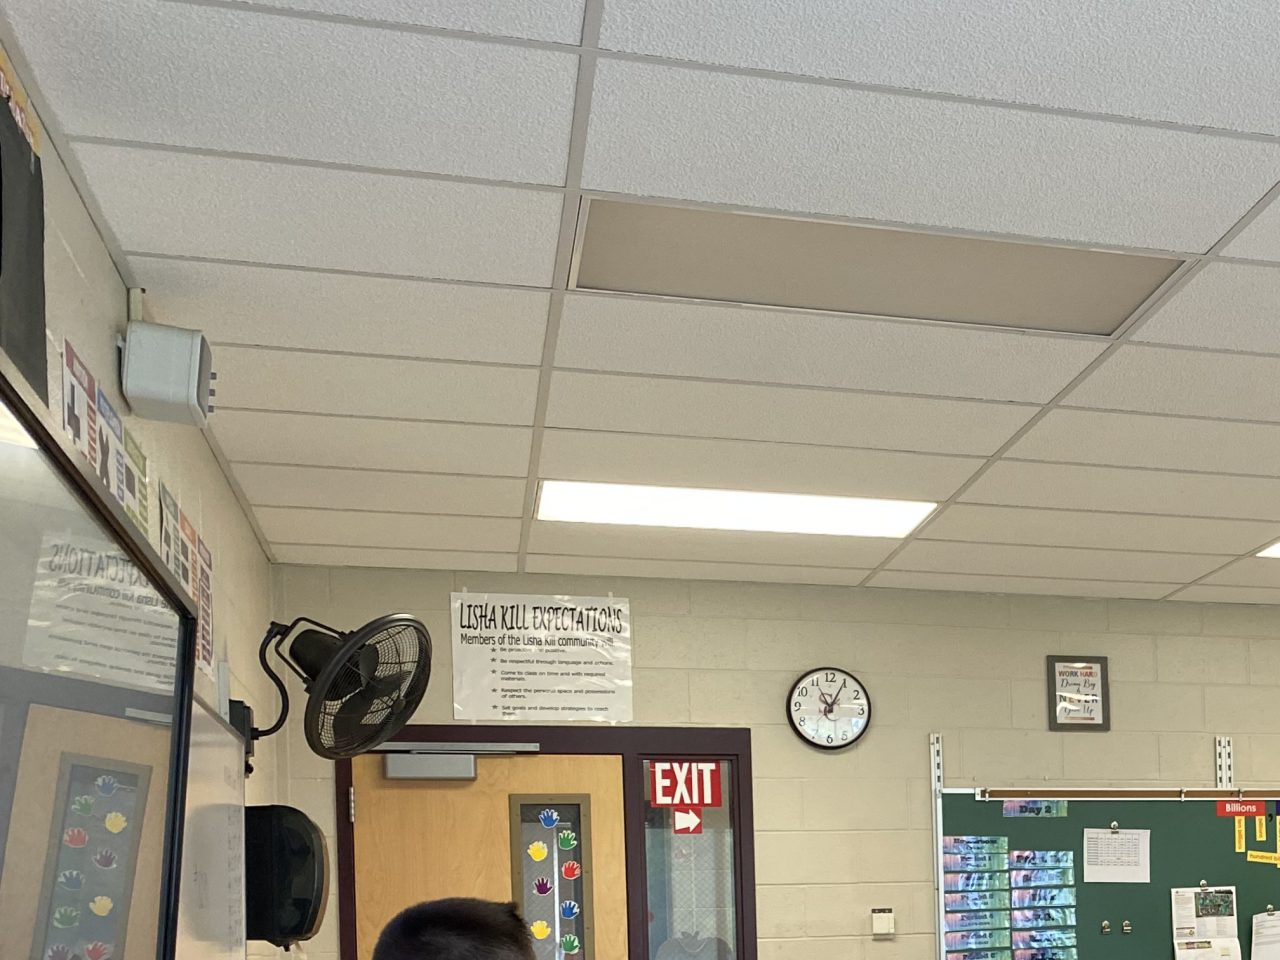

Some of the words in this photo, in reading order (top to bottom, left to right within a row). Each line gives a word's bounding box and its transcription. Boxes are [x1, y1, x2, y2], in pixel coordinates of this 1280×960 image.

[460, 603, 497, 631] LISHA
[501, 605, 528, 630] KILL
[533, 606, 622, 633] EXPECTATIONS
[461, 634, 495, 645] Members
[498, 634, 506, 645] of
[508, 635, 520, 645] the
[523, 635, 542, 646] Lisha
[812, 677, 819, 686] 11
[825, 673, 836, 682] 12
[798, 687, 807, 697] 10
[853, 690, 860, 700] 2
[794, 702, 801, 712] 9
[858, 705, 864, 715] 3
[799, 717, 805, 726] 8
[827, 735, 833, 744] 6
[841, 731, 847, 740] 5
[655, 762, 716, 804] EXIT
[1020, 806, 1042, 815] Day
[1045, 806, 1052, 814] 2
[1225, 803, 1256, 812] Billions
